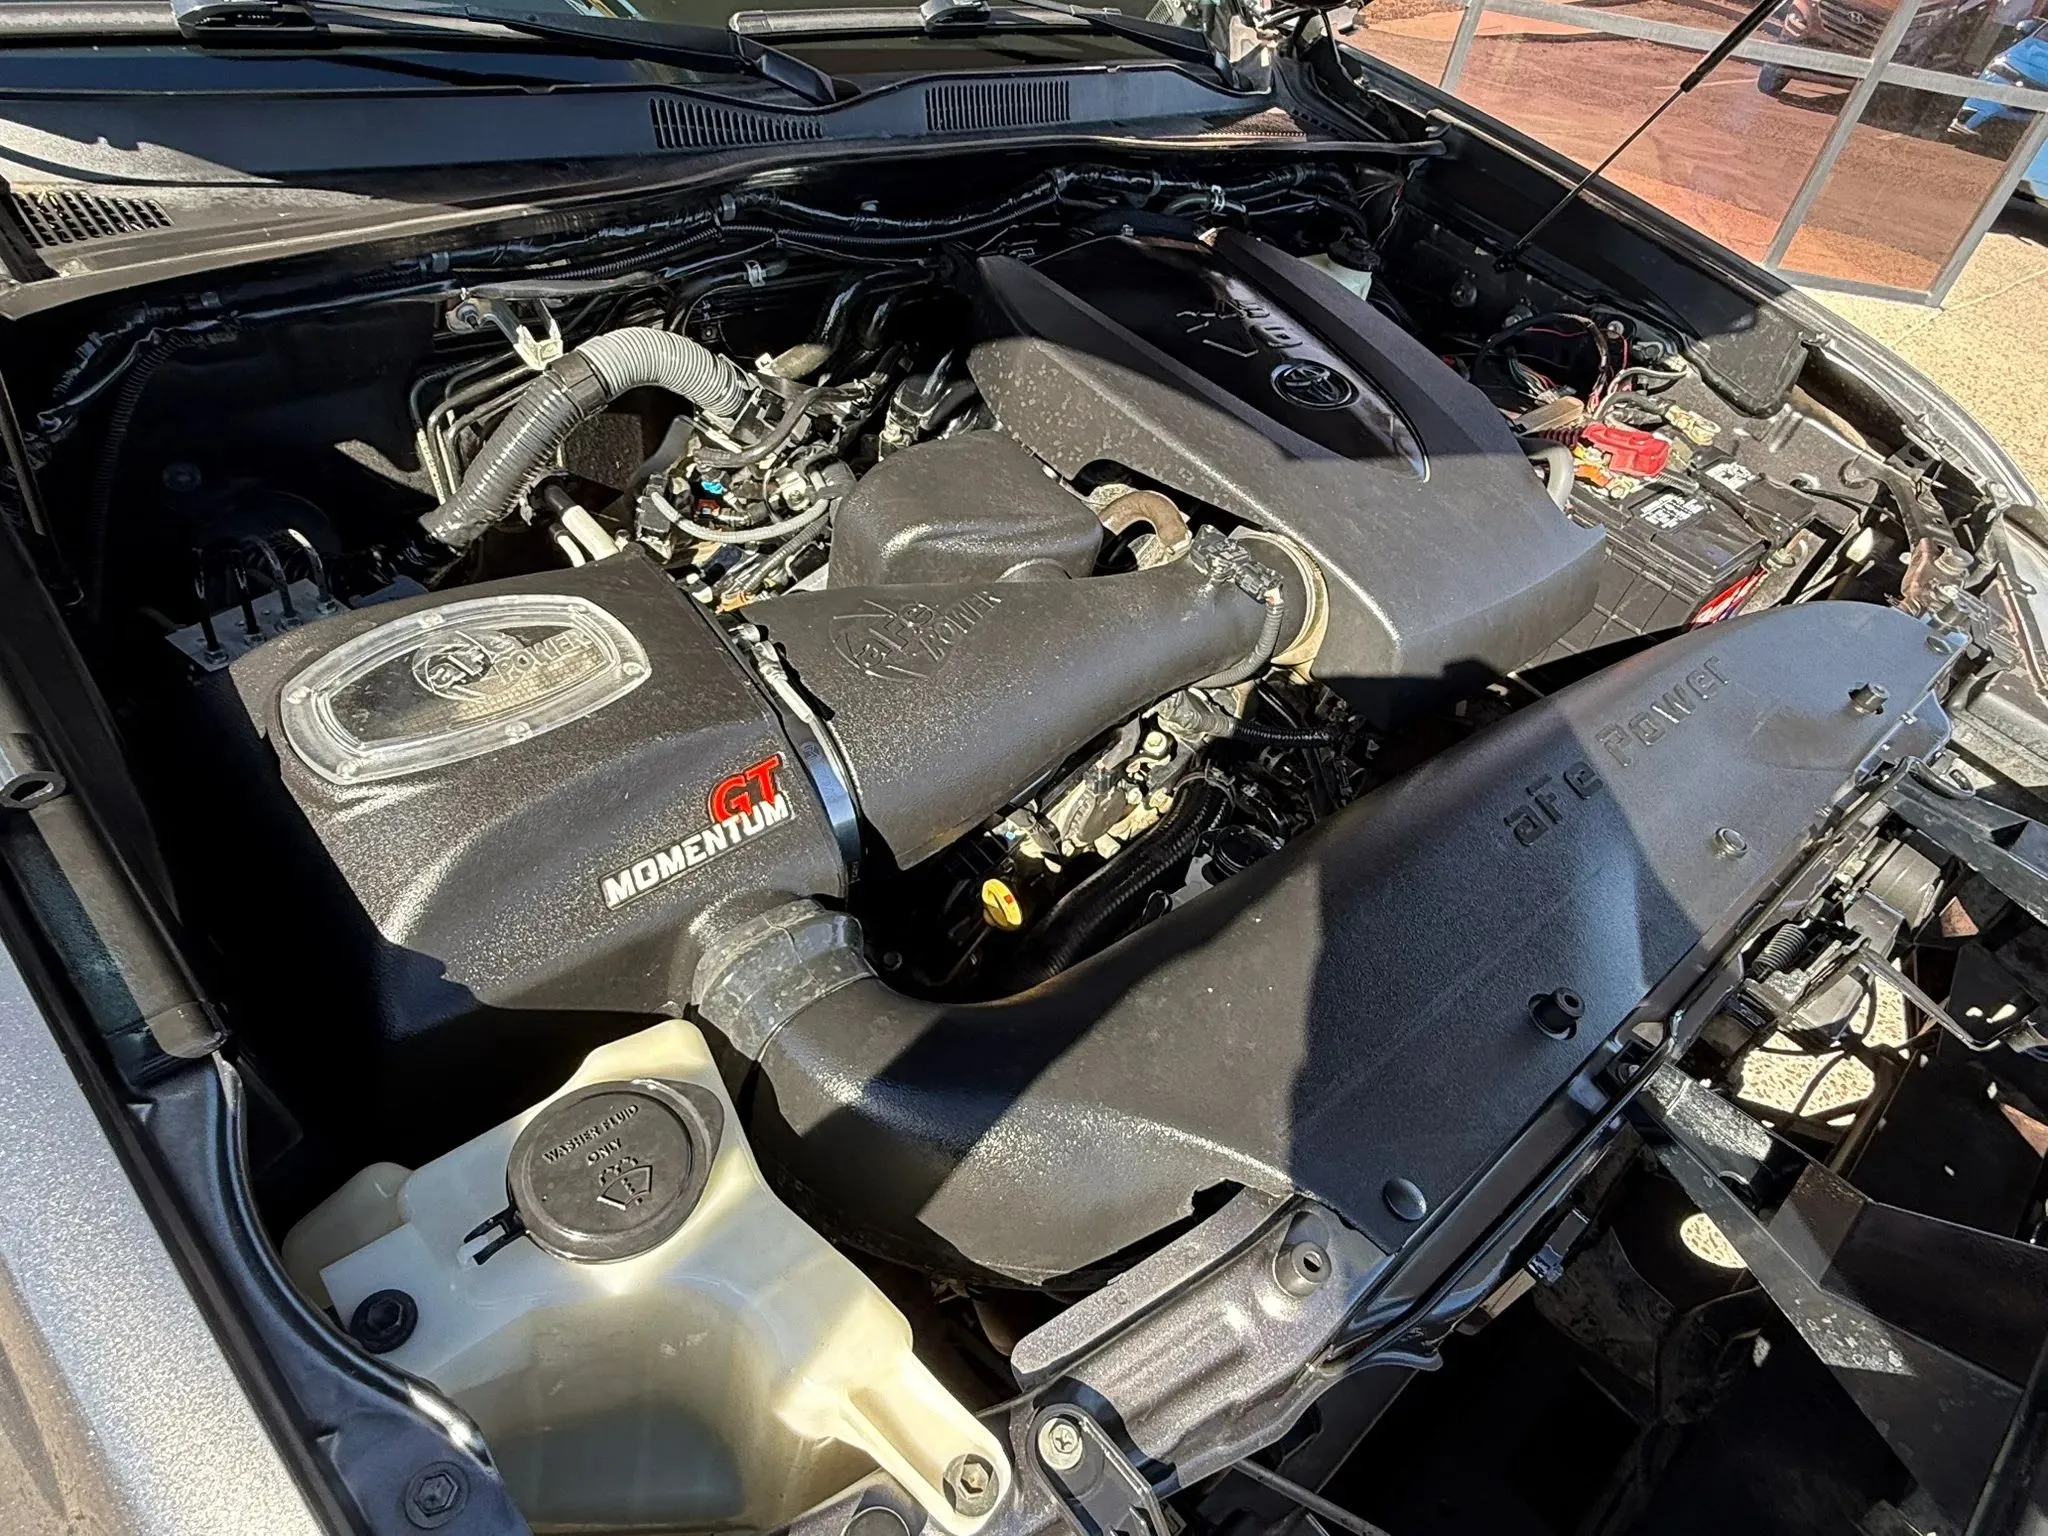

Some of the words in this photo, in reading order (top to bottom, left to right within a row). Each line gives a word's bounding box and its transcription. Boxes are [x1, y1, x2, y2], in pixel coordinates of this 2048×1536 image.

[496, 627, 592, 685] POWER
[711, 754, 780, 823] GT
[602, 793, 791, 908] MOMENTUM
[541, 1124, 601, 1164] WASHER
[601, 1104, 640, 1133] FLUID
[586, 1138, 623, 1167] ONLY
